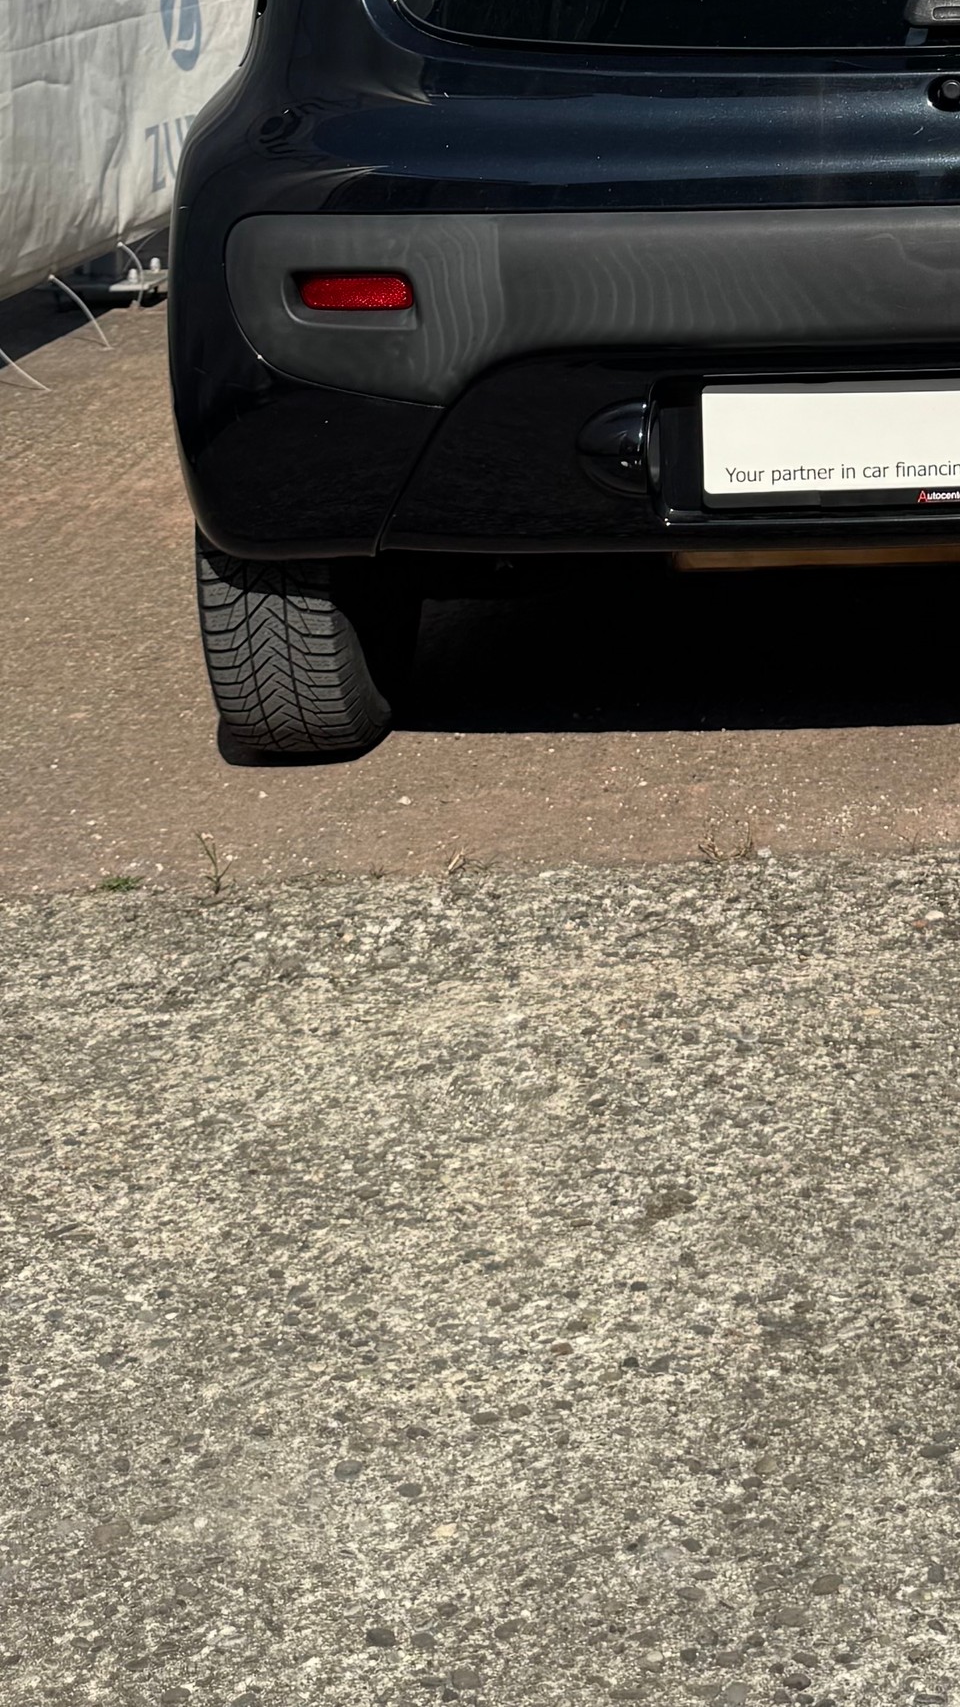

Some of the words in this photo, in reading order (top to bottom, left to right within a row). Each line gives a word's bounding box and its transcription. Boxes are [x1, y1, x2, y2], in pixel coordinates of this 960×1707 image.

[144, 114, 198, 193] ZU
[725, 467, 765, 483] Your
[772, 465, 835, 485] partner
[841, 464, 856, 479] in
[863, 466, 890, 479] car
